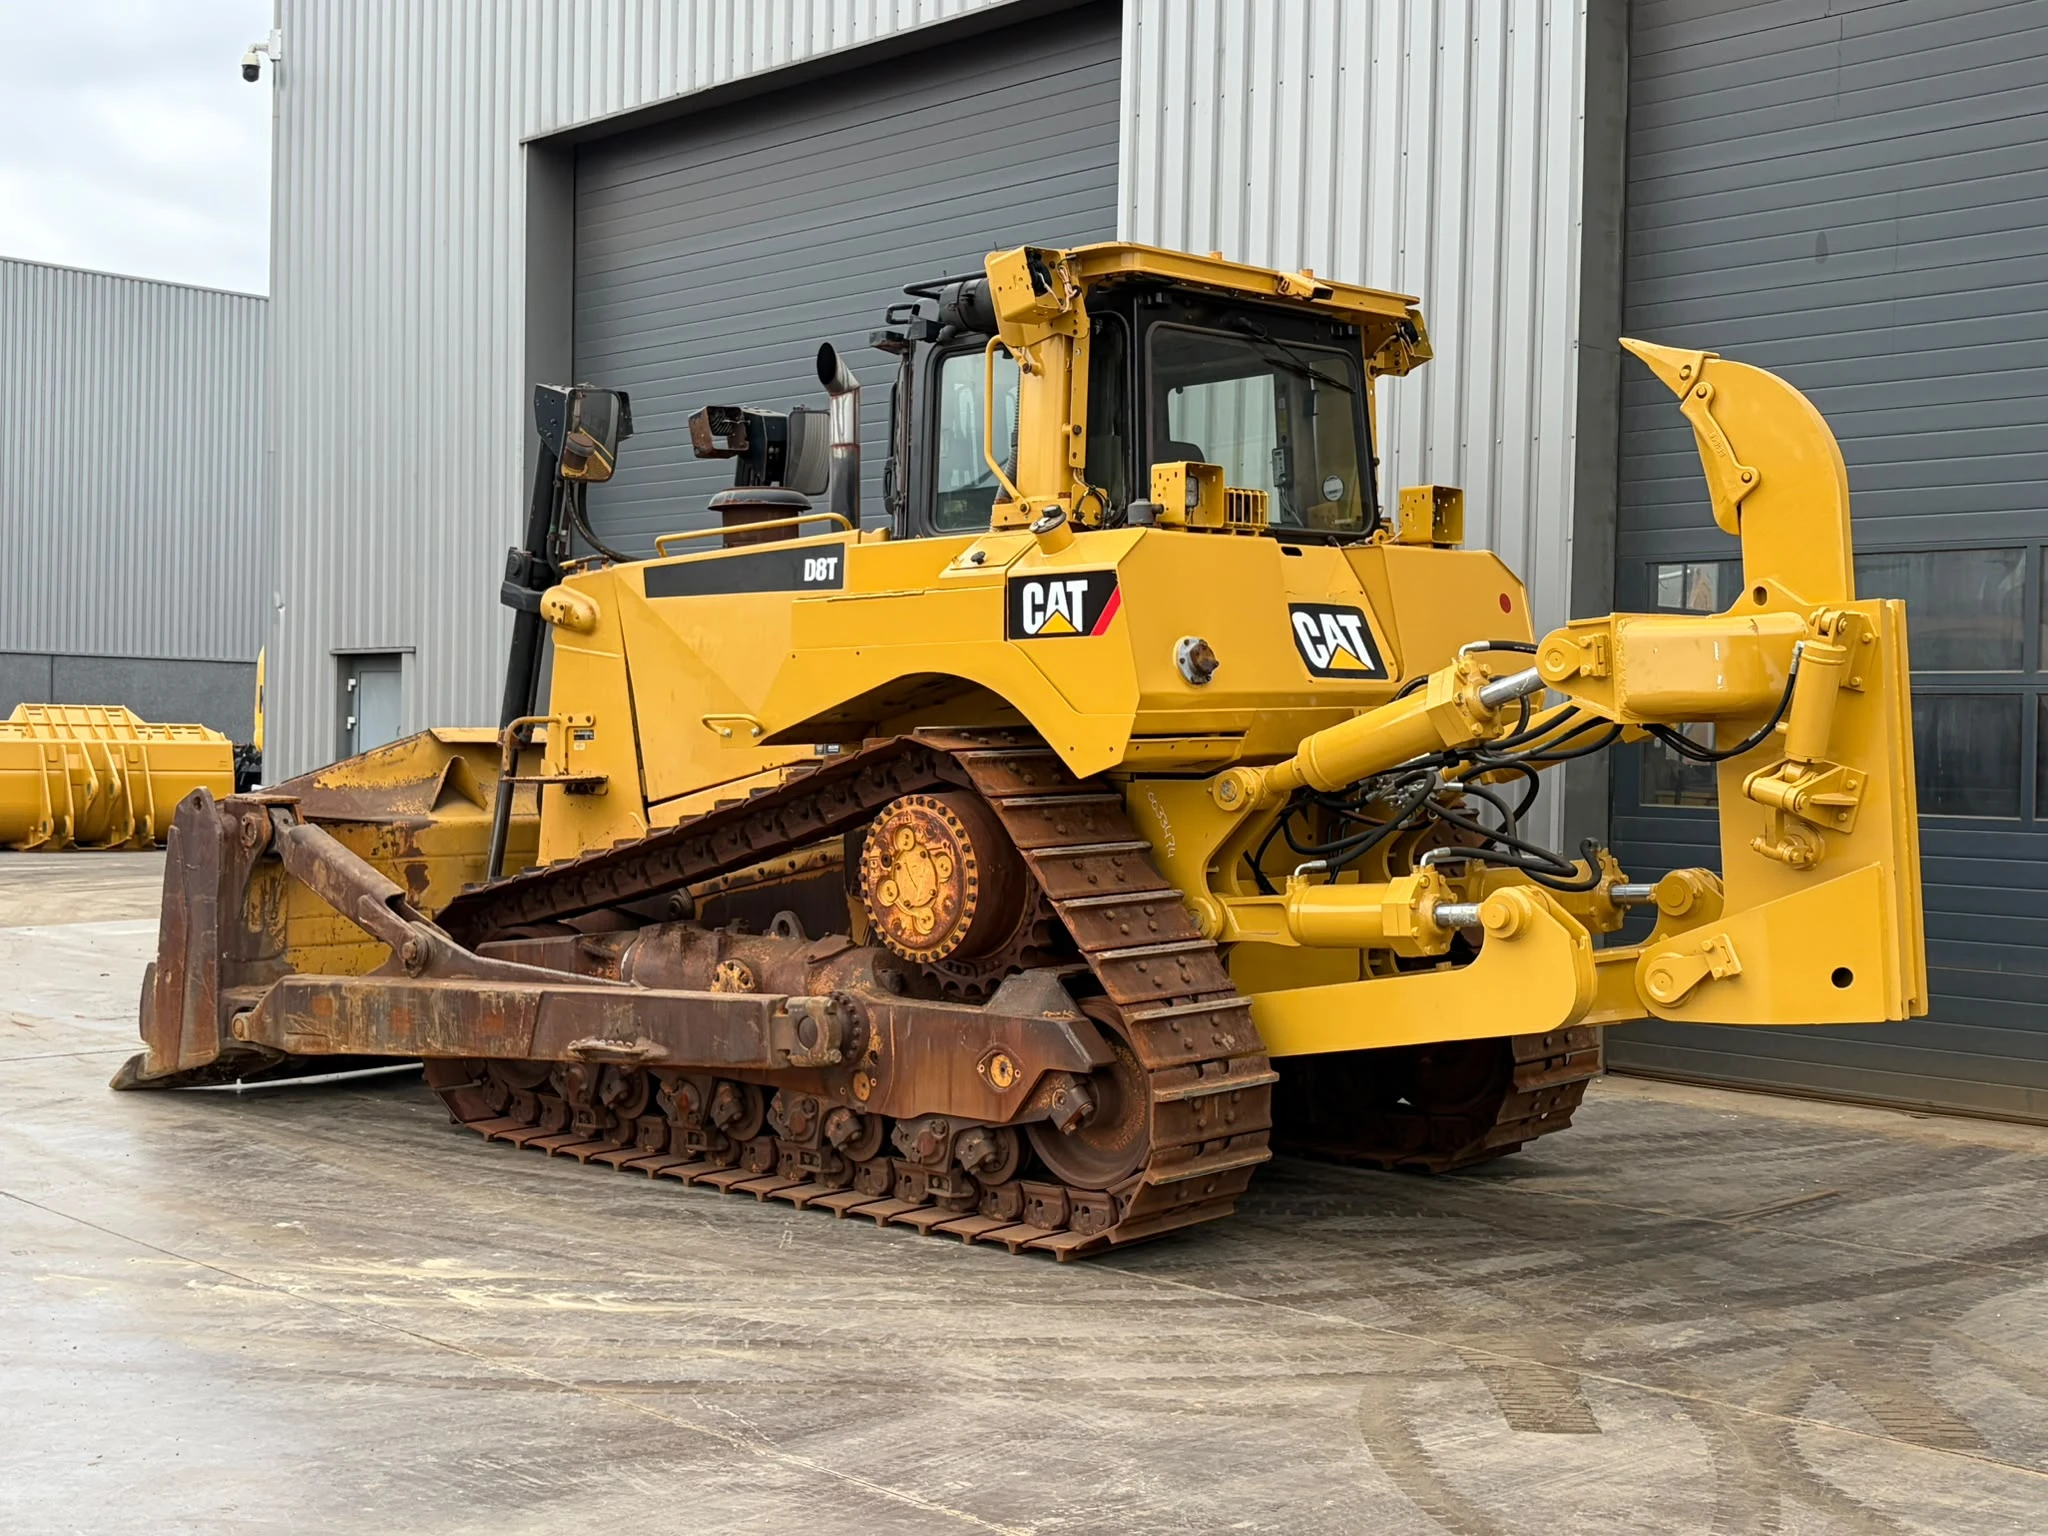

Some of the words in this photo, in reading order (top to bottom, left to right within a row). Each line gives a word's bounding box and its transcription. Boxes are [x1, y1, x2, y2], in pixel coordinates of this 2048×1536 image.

[803, 556, 838, 582] D8T
[1022, 580, 1088, 635] CAT
[1291, 611, 1376, 671] CAT
